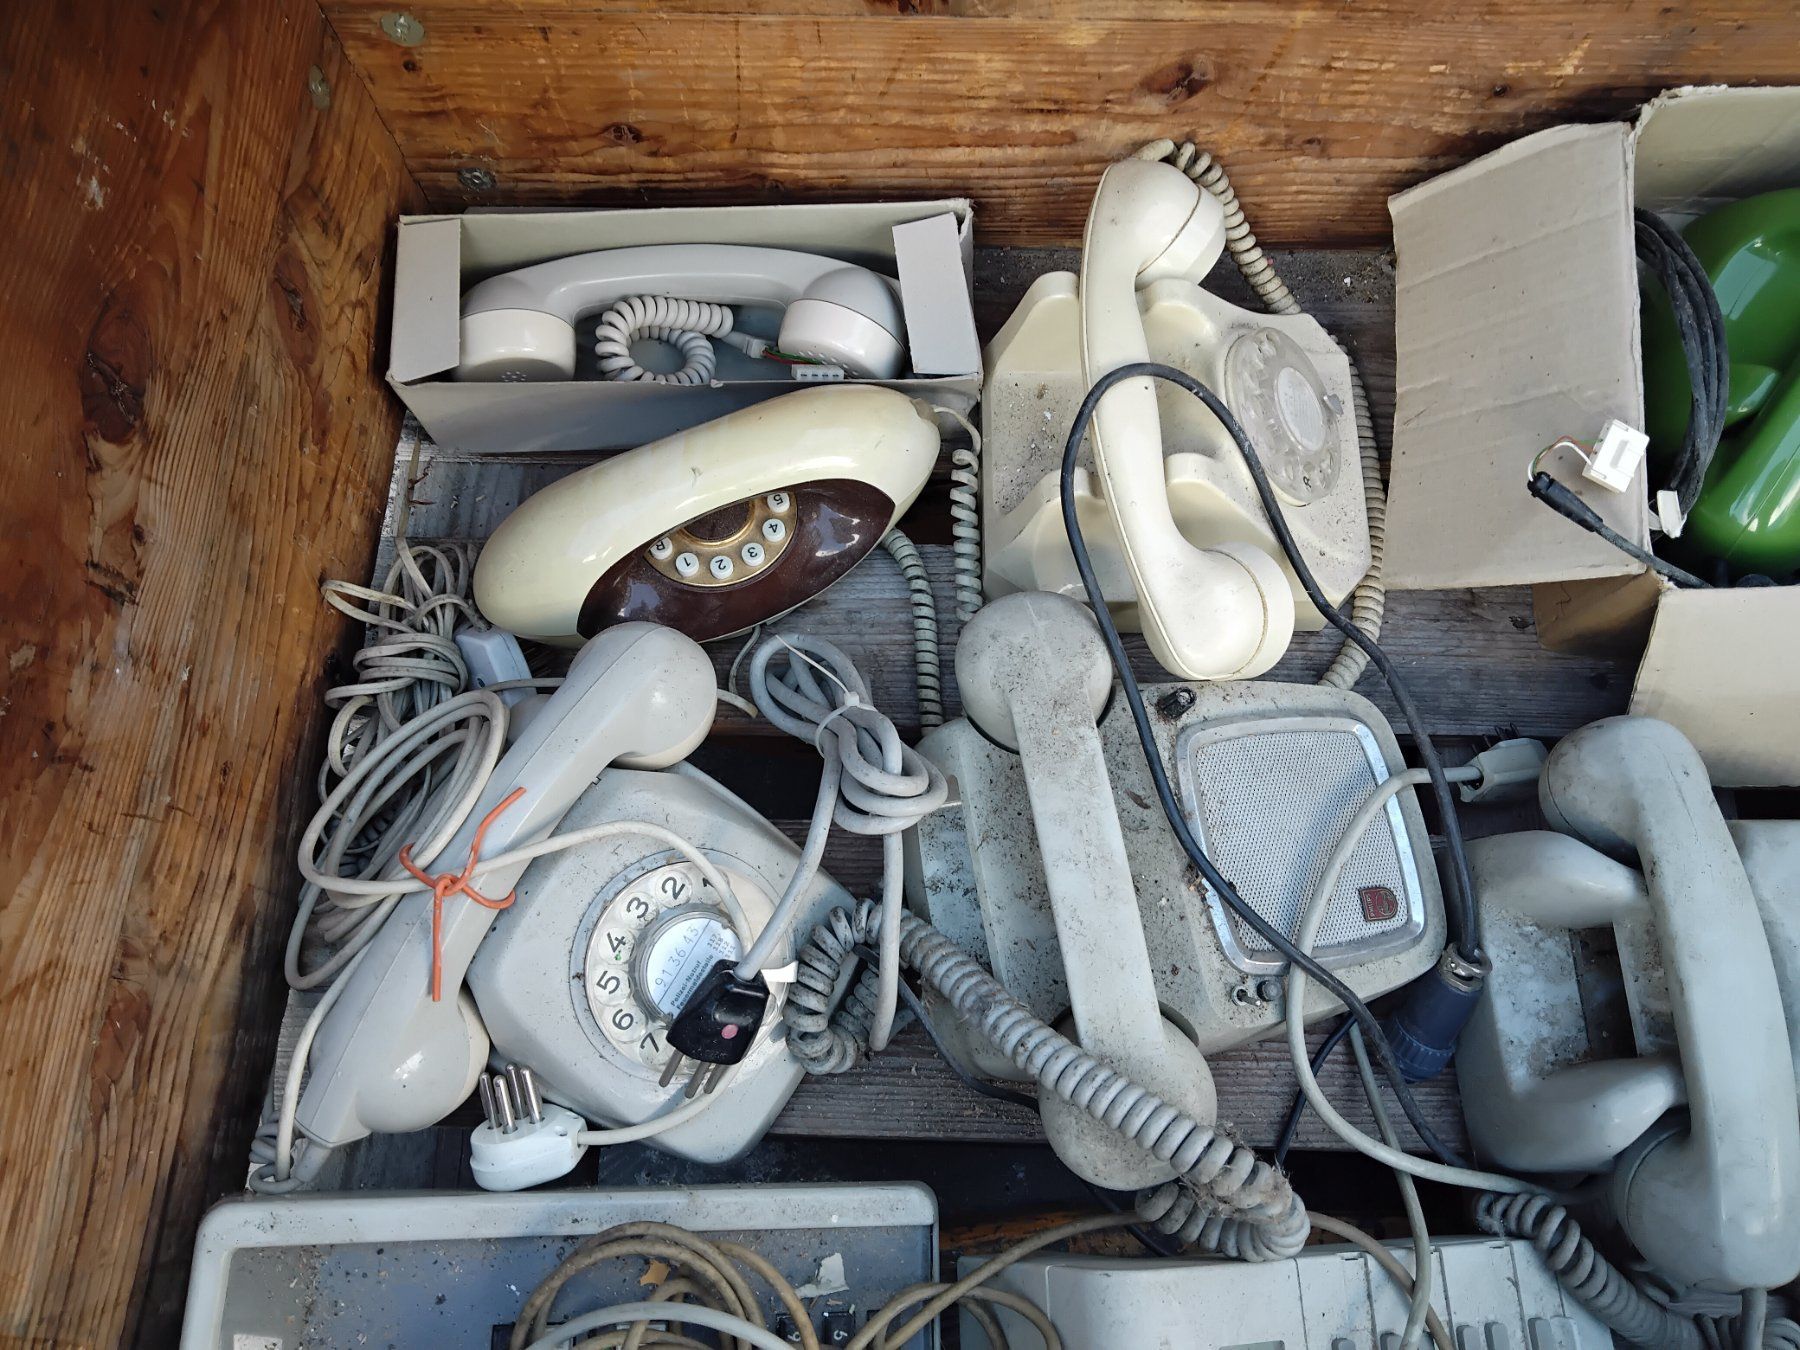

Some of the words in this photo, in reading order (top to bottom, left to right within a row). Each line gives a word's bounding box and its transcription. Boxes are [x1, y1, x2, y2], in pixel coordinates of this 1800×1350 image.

[773, 494, 783, 505] 5
[768, 523, 778, 533] 4
[683, 557, 692, 567] 1
[747, 546, 758, 558] 3
[715, 559, 727, 570] 2
[661, 876, 686, 900] 2
[626, 897, 650, 919] 3
[606, 931, 627, 953] 4
[596, 970, 620, 995] 5
[612, 1008, 634, 1031] 6
[640, 1032, 660, 1053] 7
